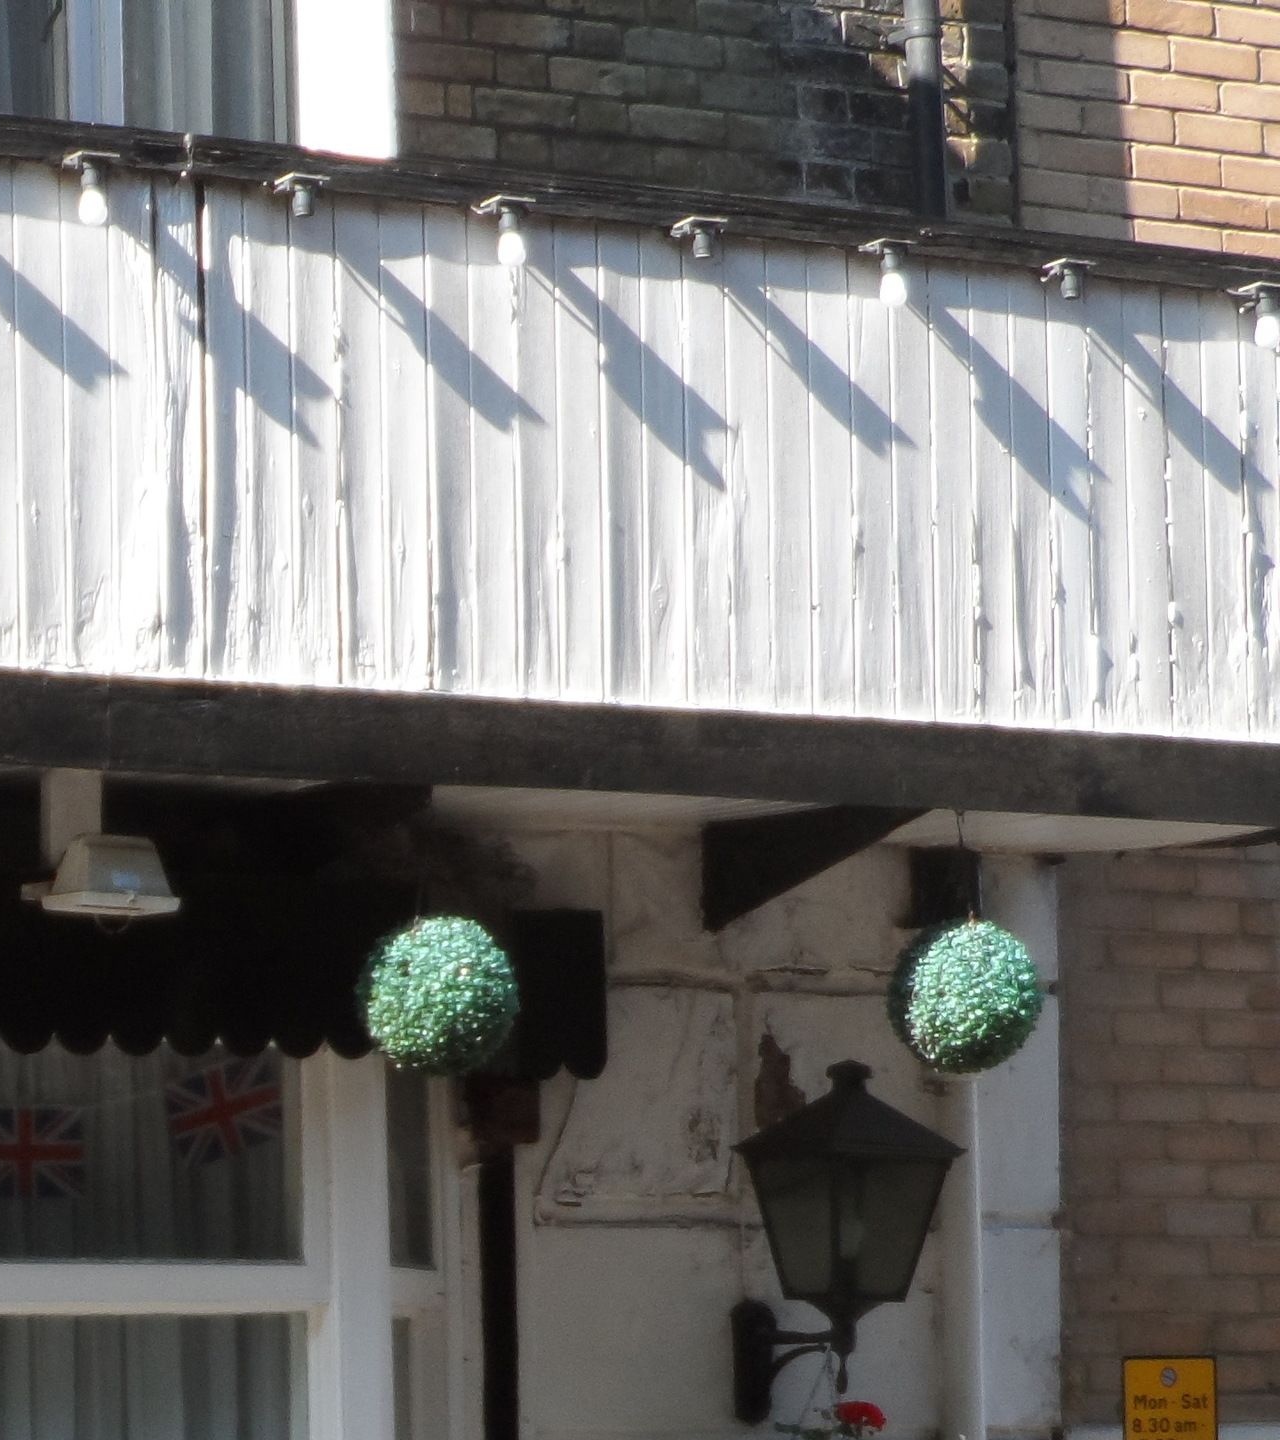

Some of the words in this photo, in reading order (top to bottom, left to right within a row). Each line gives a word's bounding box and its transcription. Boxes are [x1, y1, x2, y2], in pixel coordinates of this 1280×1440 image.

[1133, 1394, 1168, 1409] Mon
[1181, 1393, 1209, 1409] Sat
[1132, 1418, 1170, 1433] 8.30
[1174, 1420, 1197, 1433] am
